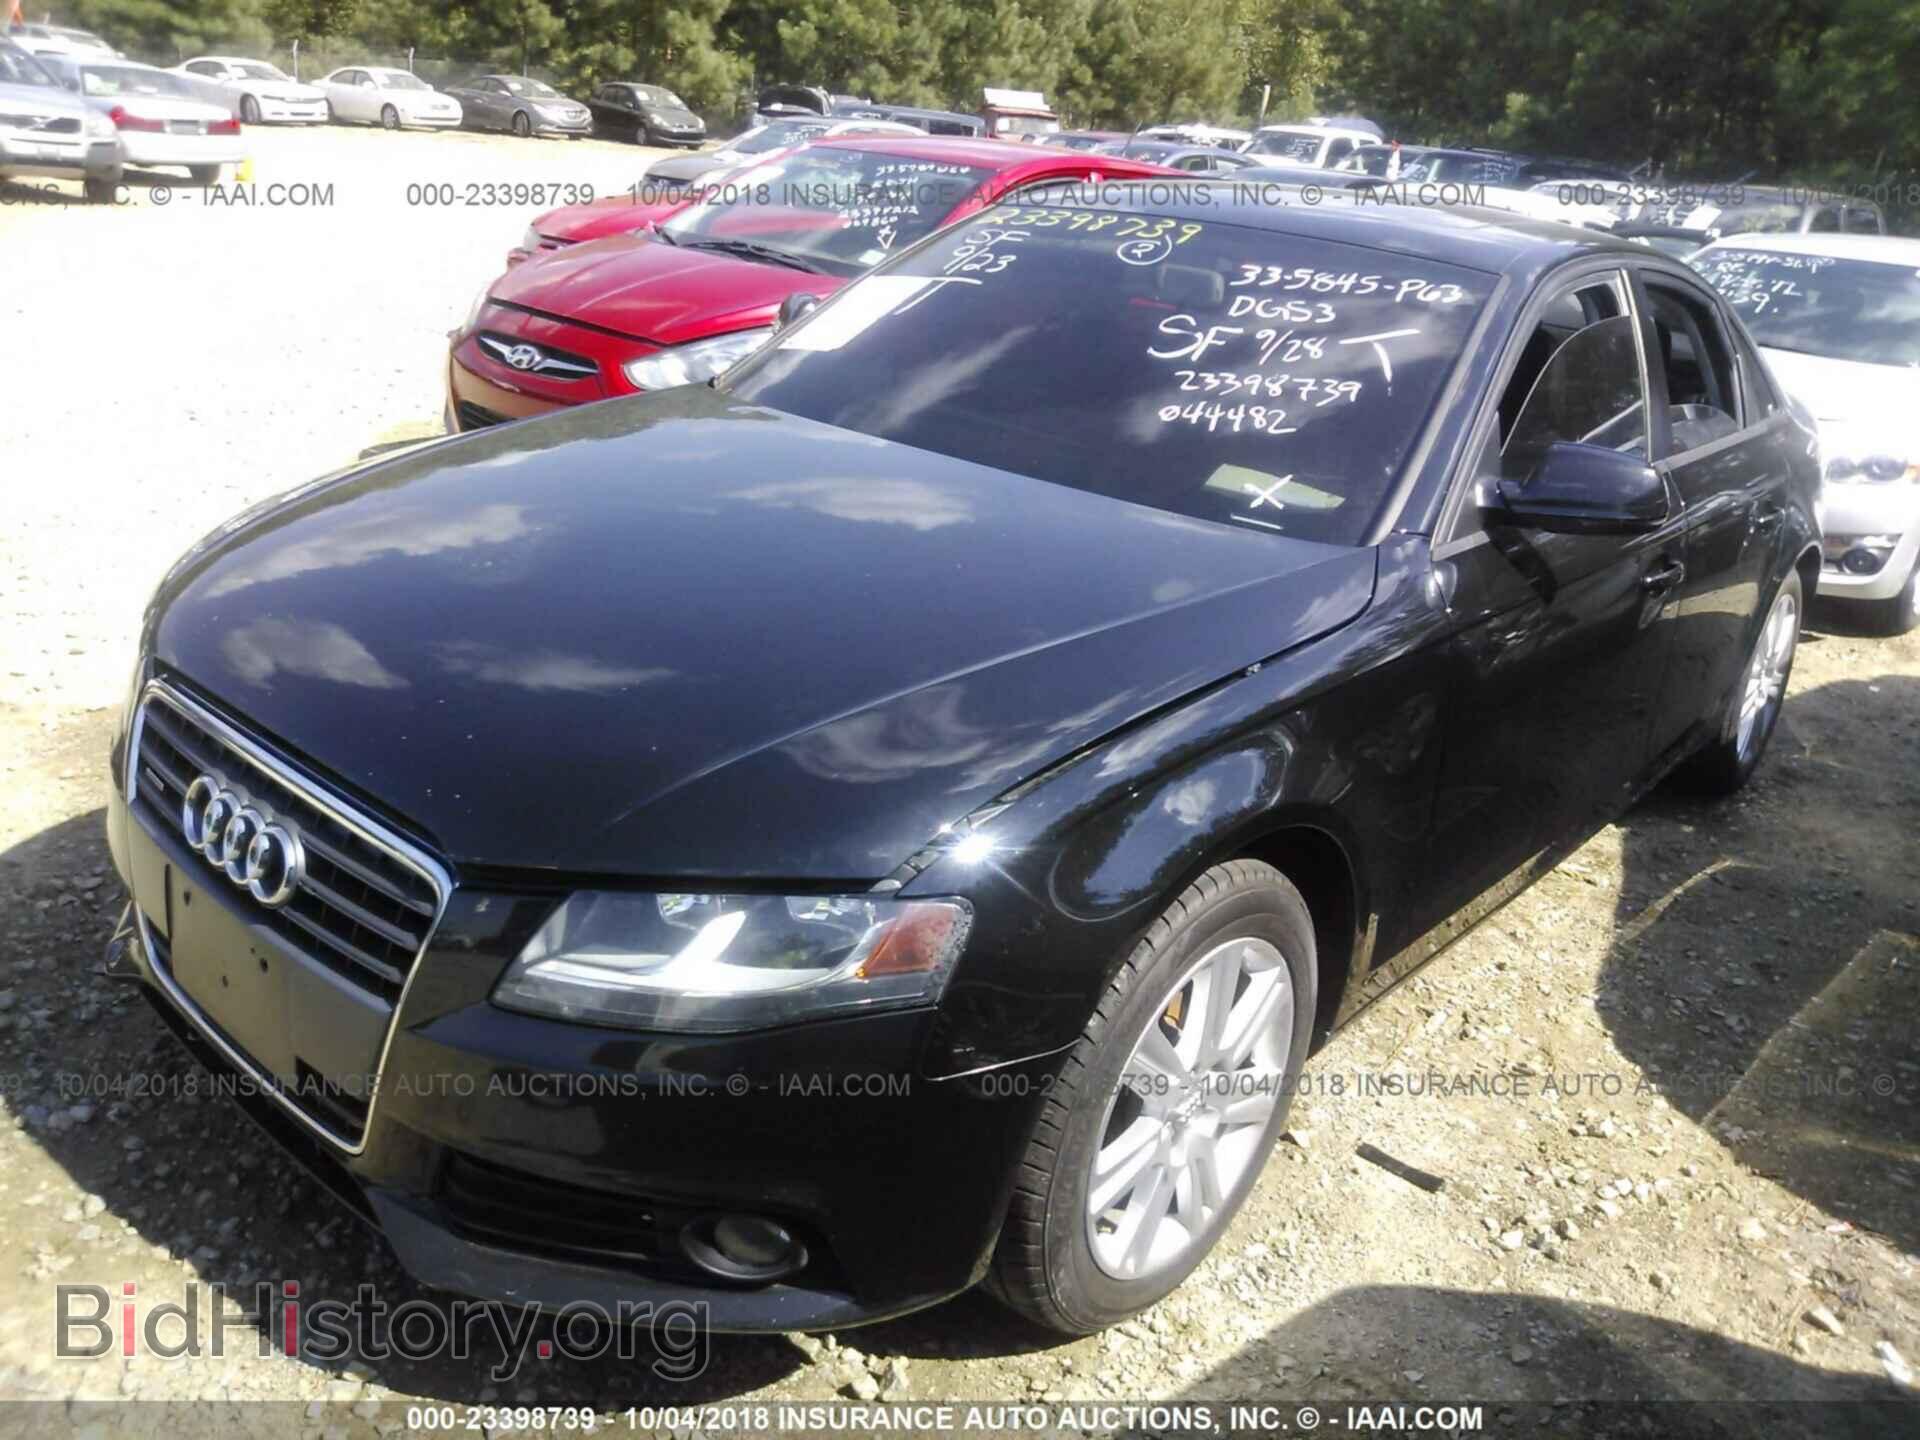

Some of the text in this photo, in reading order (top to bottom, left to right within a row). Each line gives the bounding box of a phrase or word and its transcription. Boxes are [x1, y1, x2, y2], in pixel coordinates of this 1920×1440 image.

[976, 207, 1203, 244] 23398739
[1146, 314, 1244, 361] SF
[1254, 328, 1328, 365] 9/28
[1174, 370, 1362, 407] 23398739
[1158, 400, 1297, 435] 044482
